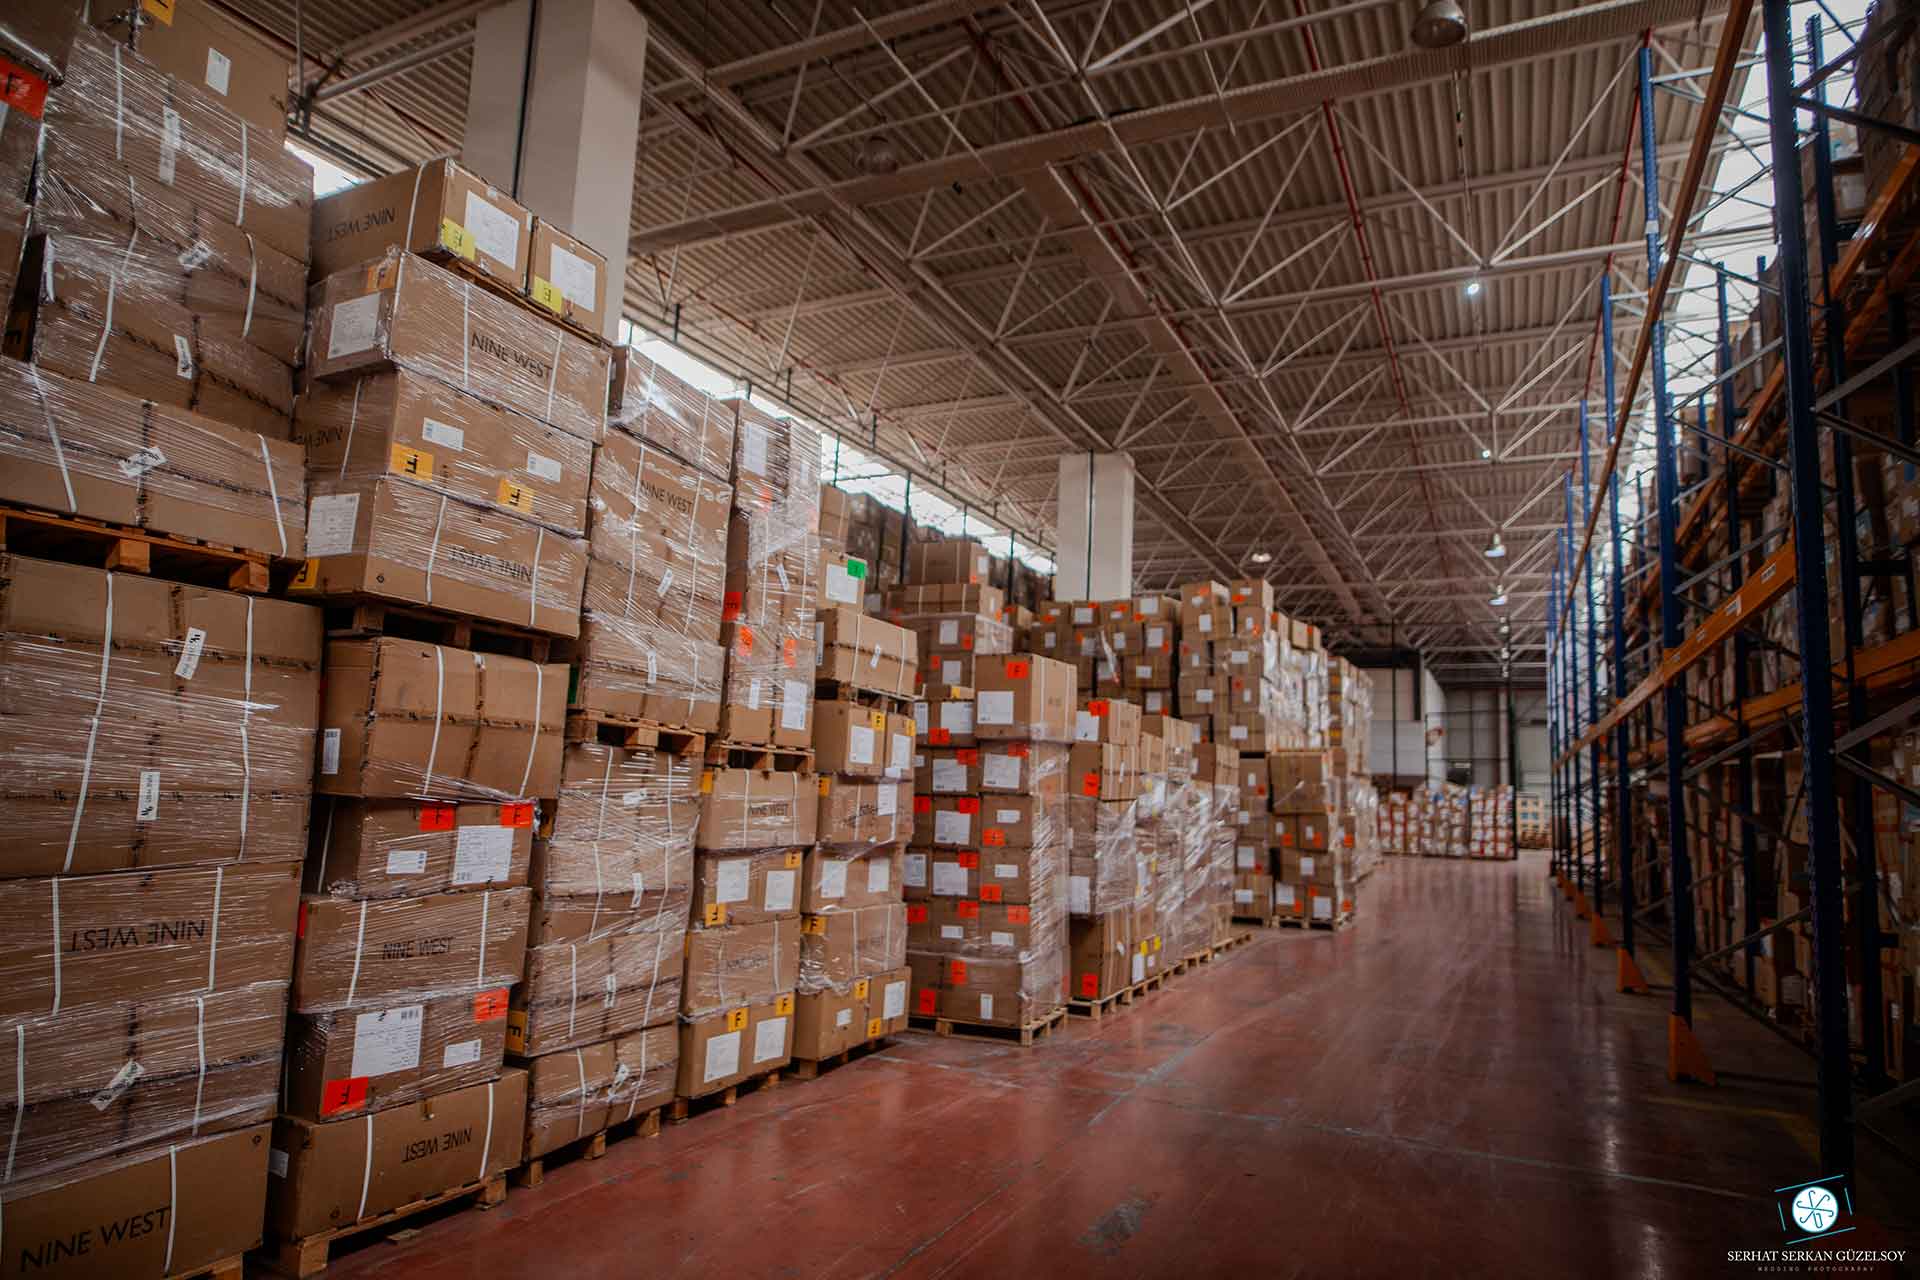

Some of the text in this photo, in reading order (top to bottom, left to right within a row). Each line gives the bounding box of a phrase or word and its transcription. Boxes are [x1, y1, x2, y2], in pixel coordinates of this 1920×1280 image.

[362, 208, 395, 231] NINE
[471, 332, 553, 381] NINE WEST
[641, 480, 665, 502] NINE
[72, 919, 205, 952] NINE WEST
[382, 936, 454, 960] NINE WEST
[401, 1127, 473, 1163] NINE WEST
[20, 1206, 171, 1273] NINE WEST
